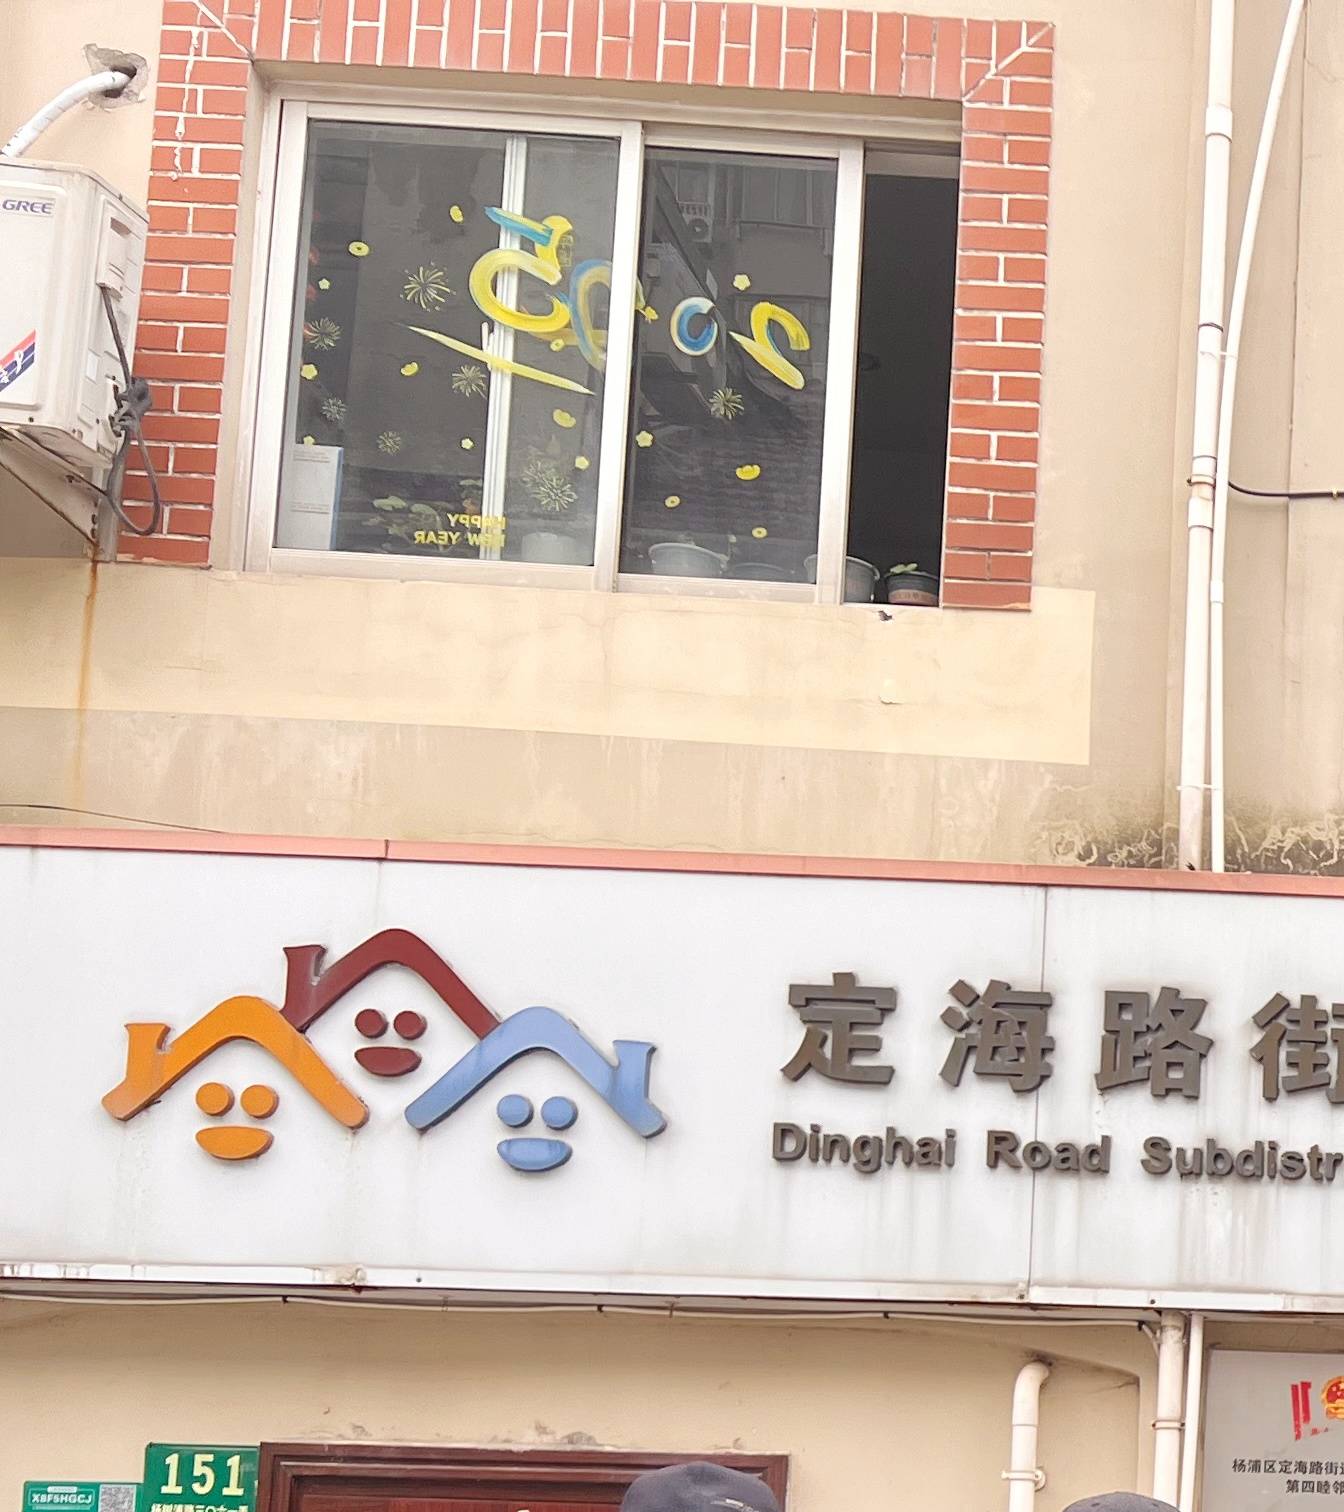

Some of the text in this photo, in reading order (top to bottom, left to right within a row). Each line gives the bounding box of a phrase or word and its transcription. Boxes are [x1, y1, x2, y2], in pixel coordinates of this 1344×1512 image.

[2, 198, 54, 215] GREE
[772, 1121, 957, 1174] Dinghai
[985, 1129, 1112, 1174] Road
[160, 1452, 245, 1497] 151
